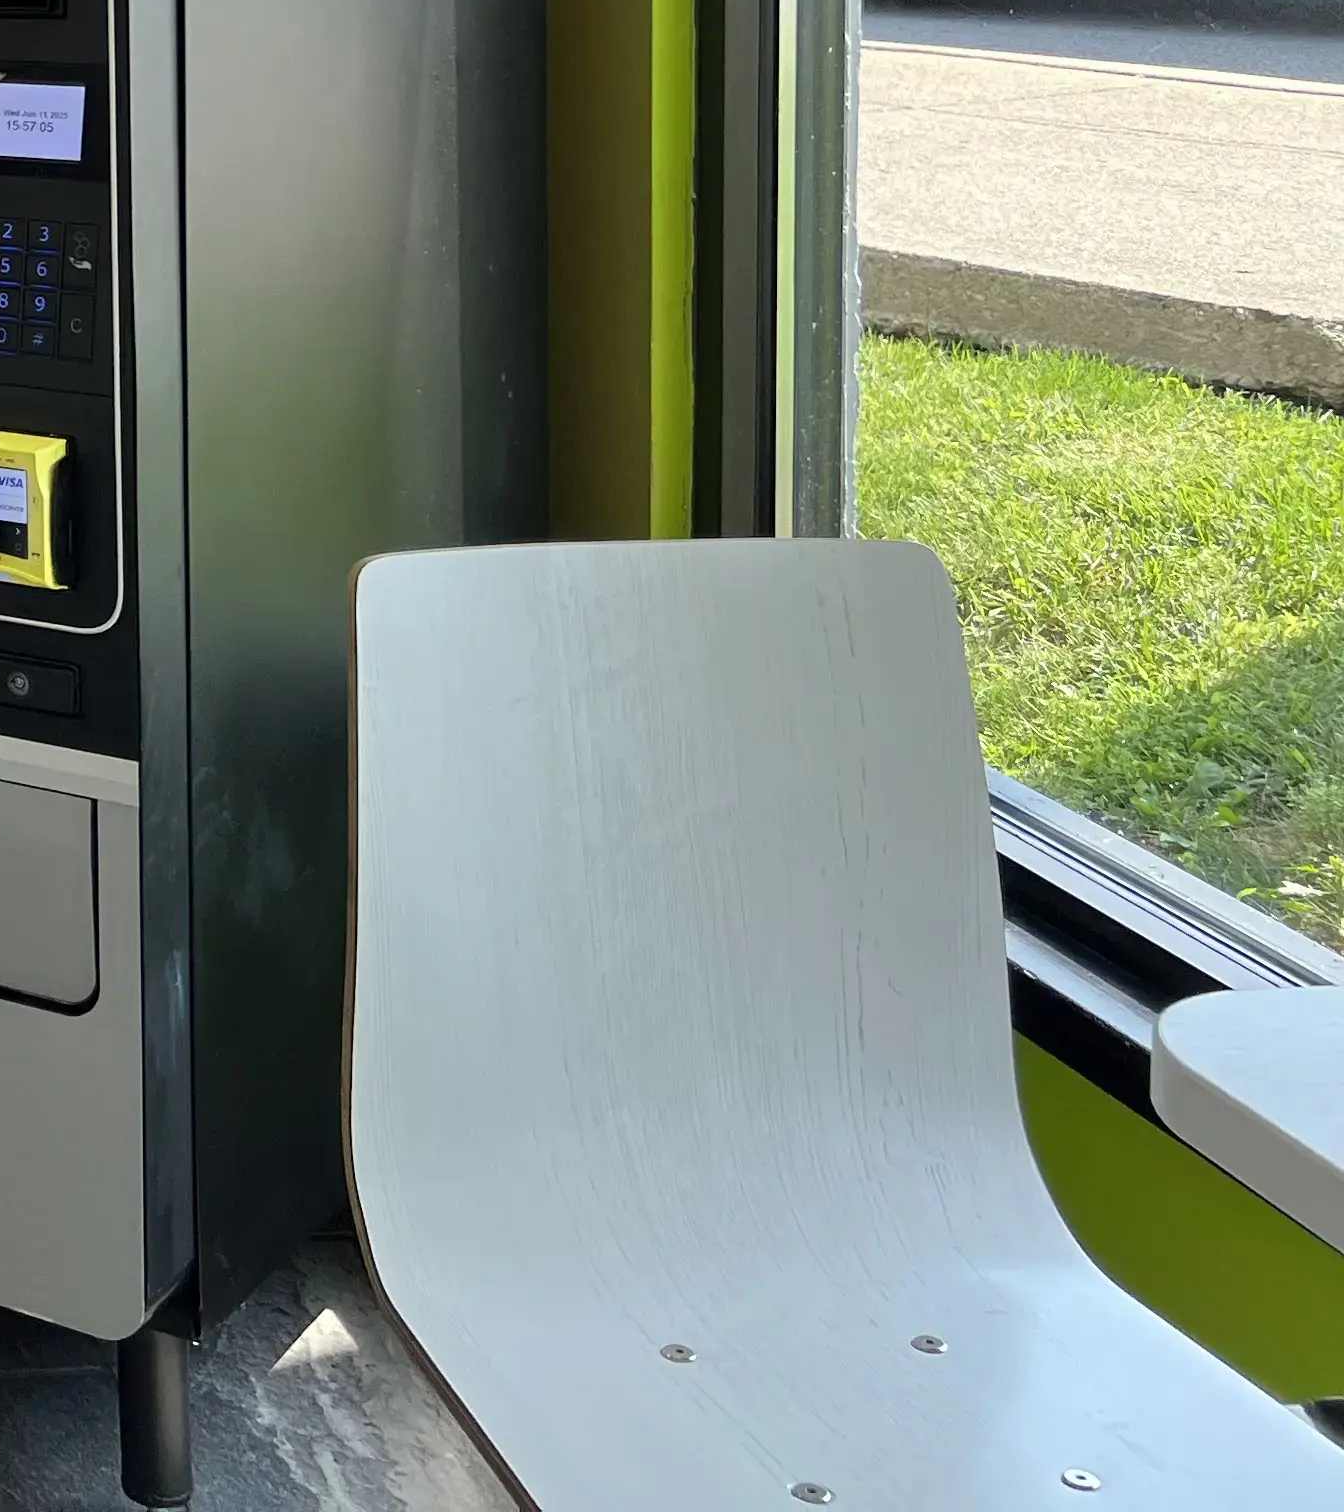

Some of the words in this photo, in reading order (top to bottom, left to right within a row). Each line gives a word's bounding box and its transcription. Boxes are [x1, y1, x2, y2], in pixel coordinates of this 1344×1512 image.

[2, 223, 13, 239] 2
[38, 226, 50, 242] 3
[0, 257, 11, 273] 5
[36, 261, 48, 277] 6
[34, 296, 46, 312] 9
[70, 318, 83, 333] C
